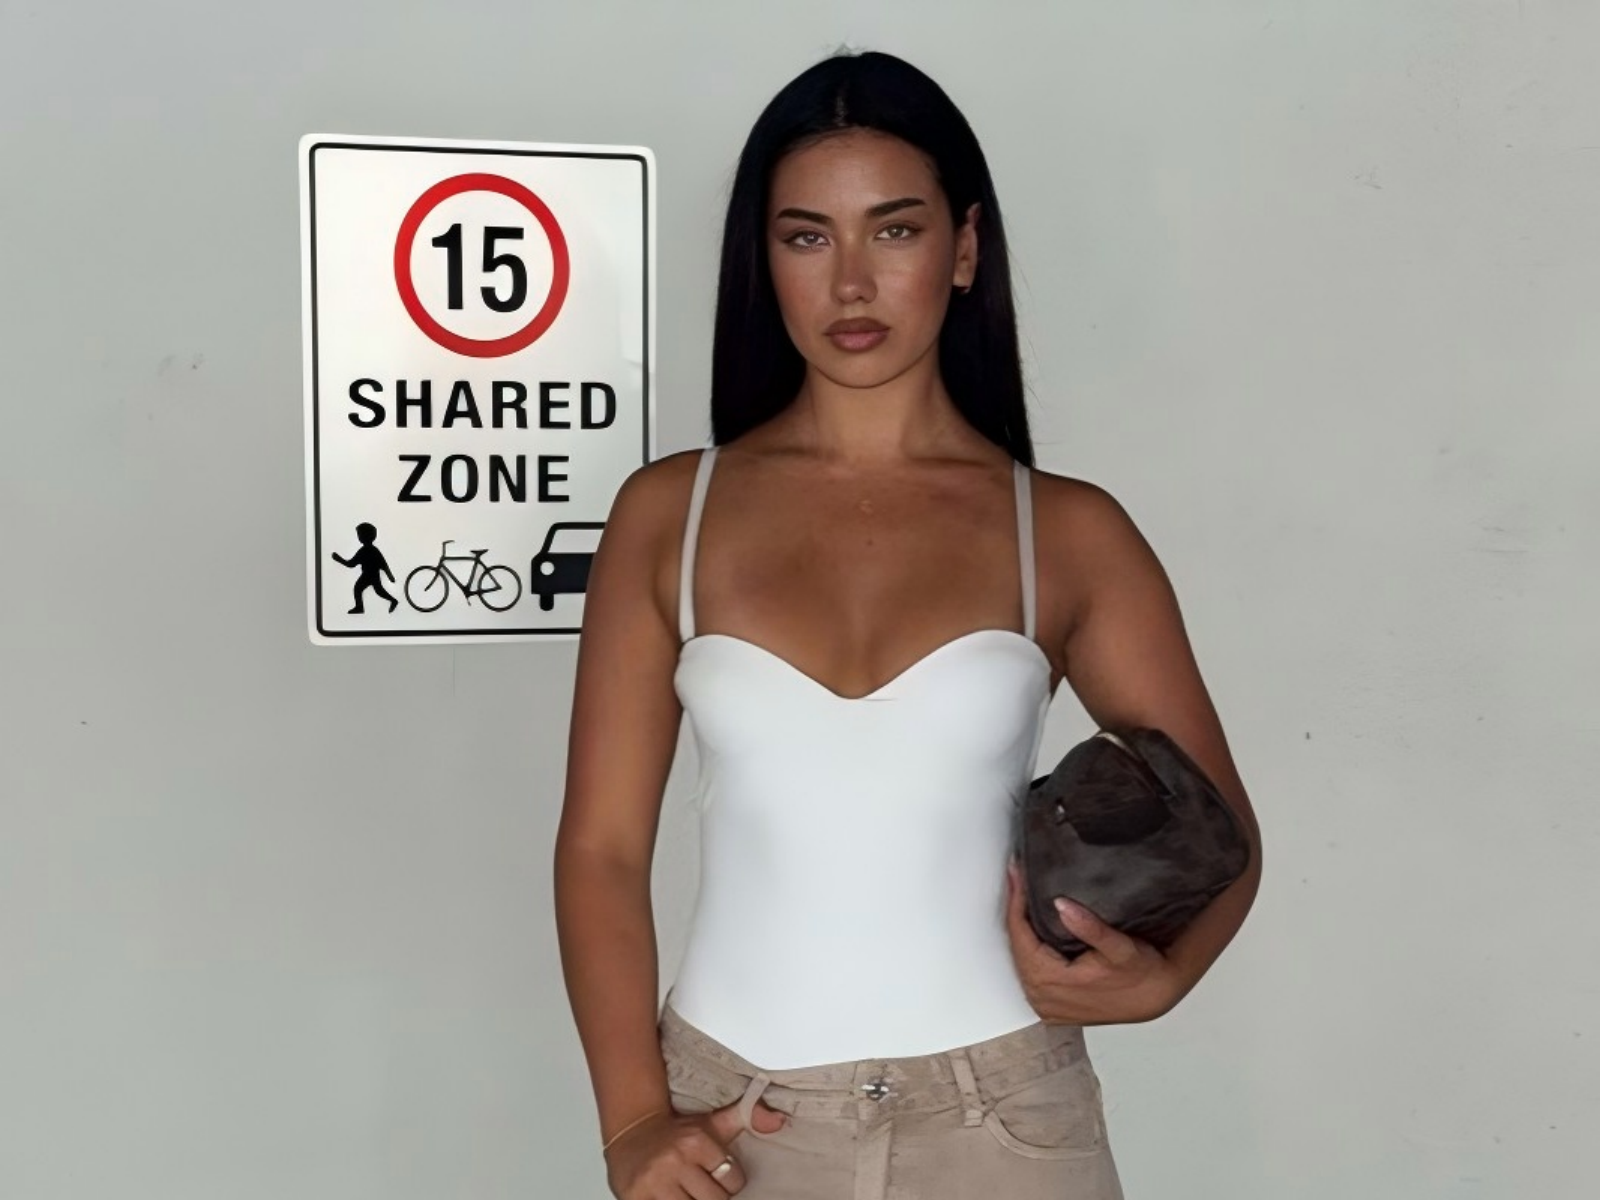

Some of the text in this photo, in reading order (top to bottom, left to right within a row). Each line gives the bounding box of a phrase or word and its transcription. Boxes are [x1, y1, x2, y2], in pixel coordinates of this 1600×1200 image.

[431, 223, 528, 313] 15
[348, 378, 617, 430] SHARED
[397, 454, 570, 504] ZONE
